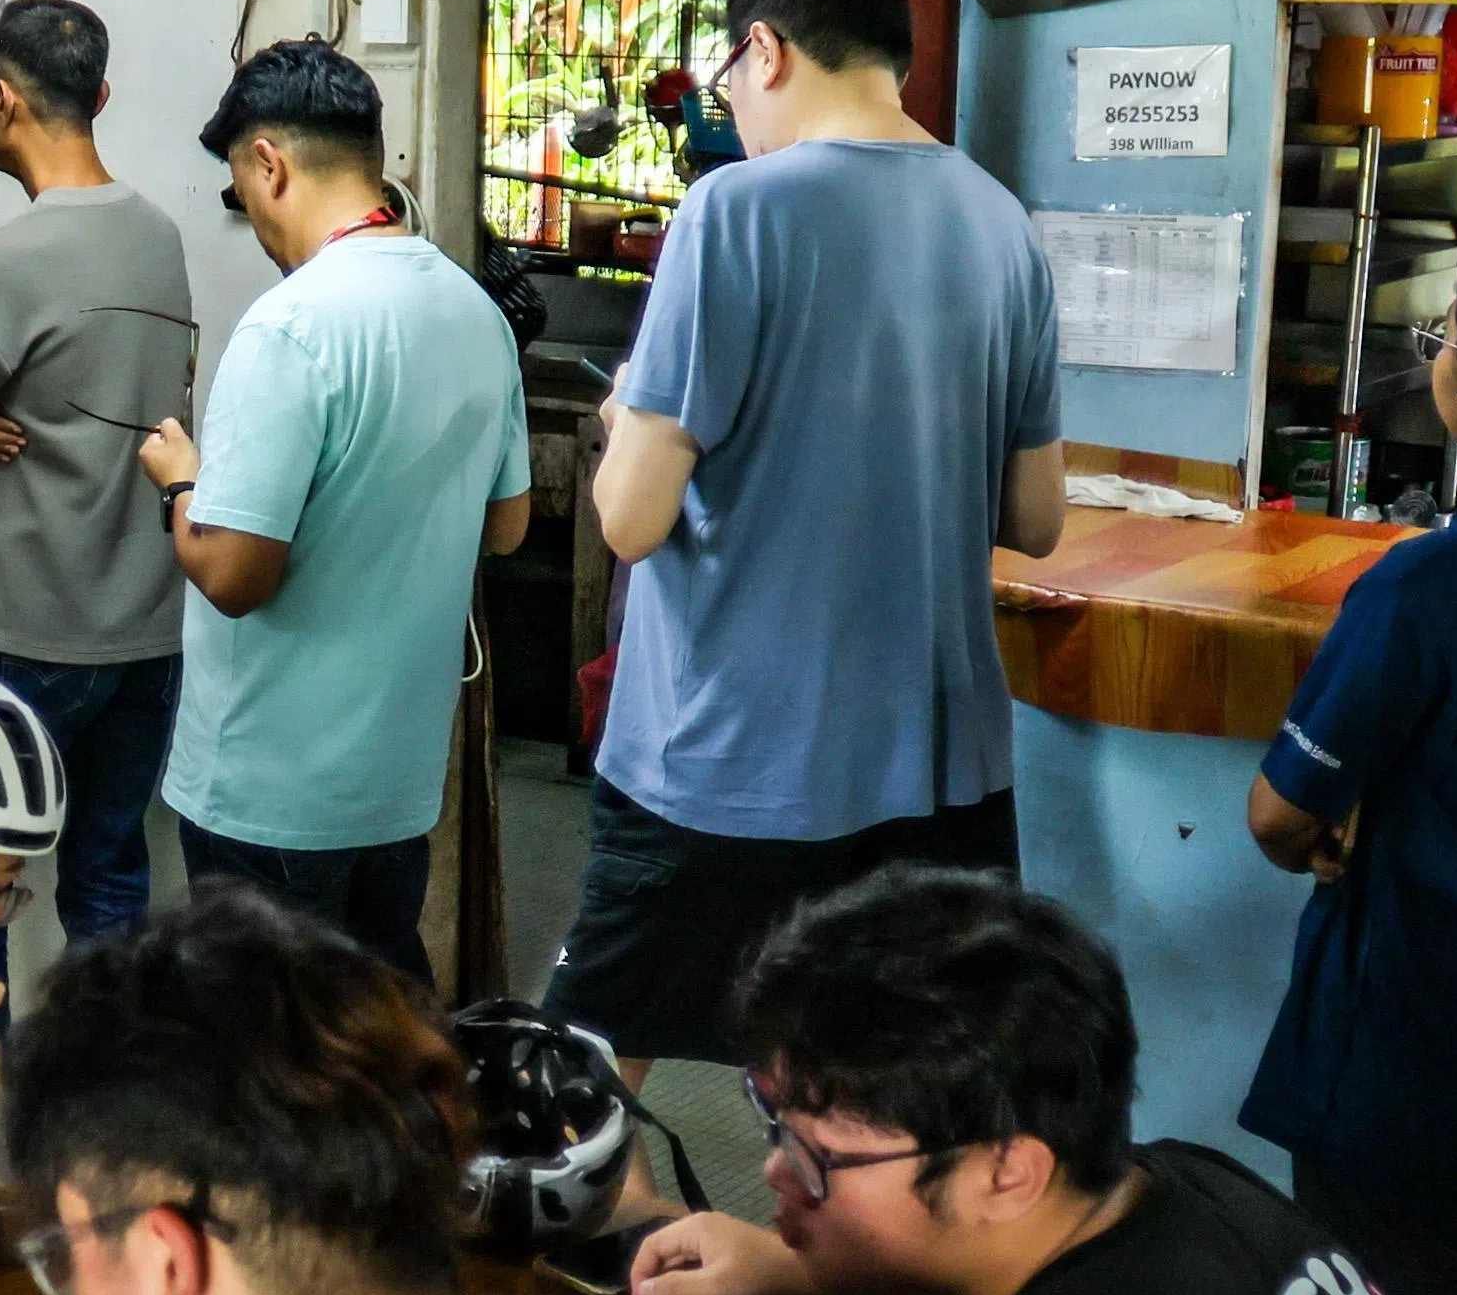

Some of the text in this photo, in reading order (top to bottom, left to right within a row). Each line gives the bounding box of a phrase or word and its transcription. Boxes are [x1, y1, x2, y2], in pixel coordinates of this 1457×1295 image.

[1380, 57, 1415, 70] FRUIT
[1109, 71, 1196, 89] PAYNOW
[1105, 106, 1199, 123] 86255253
[1109, 138, 1135, 151] 398
